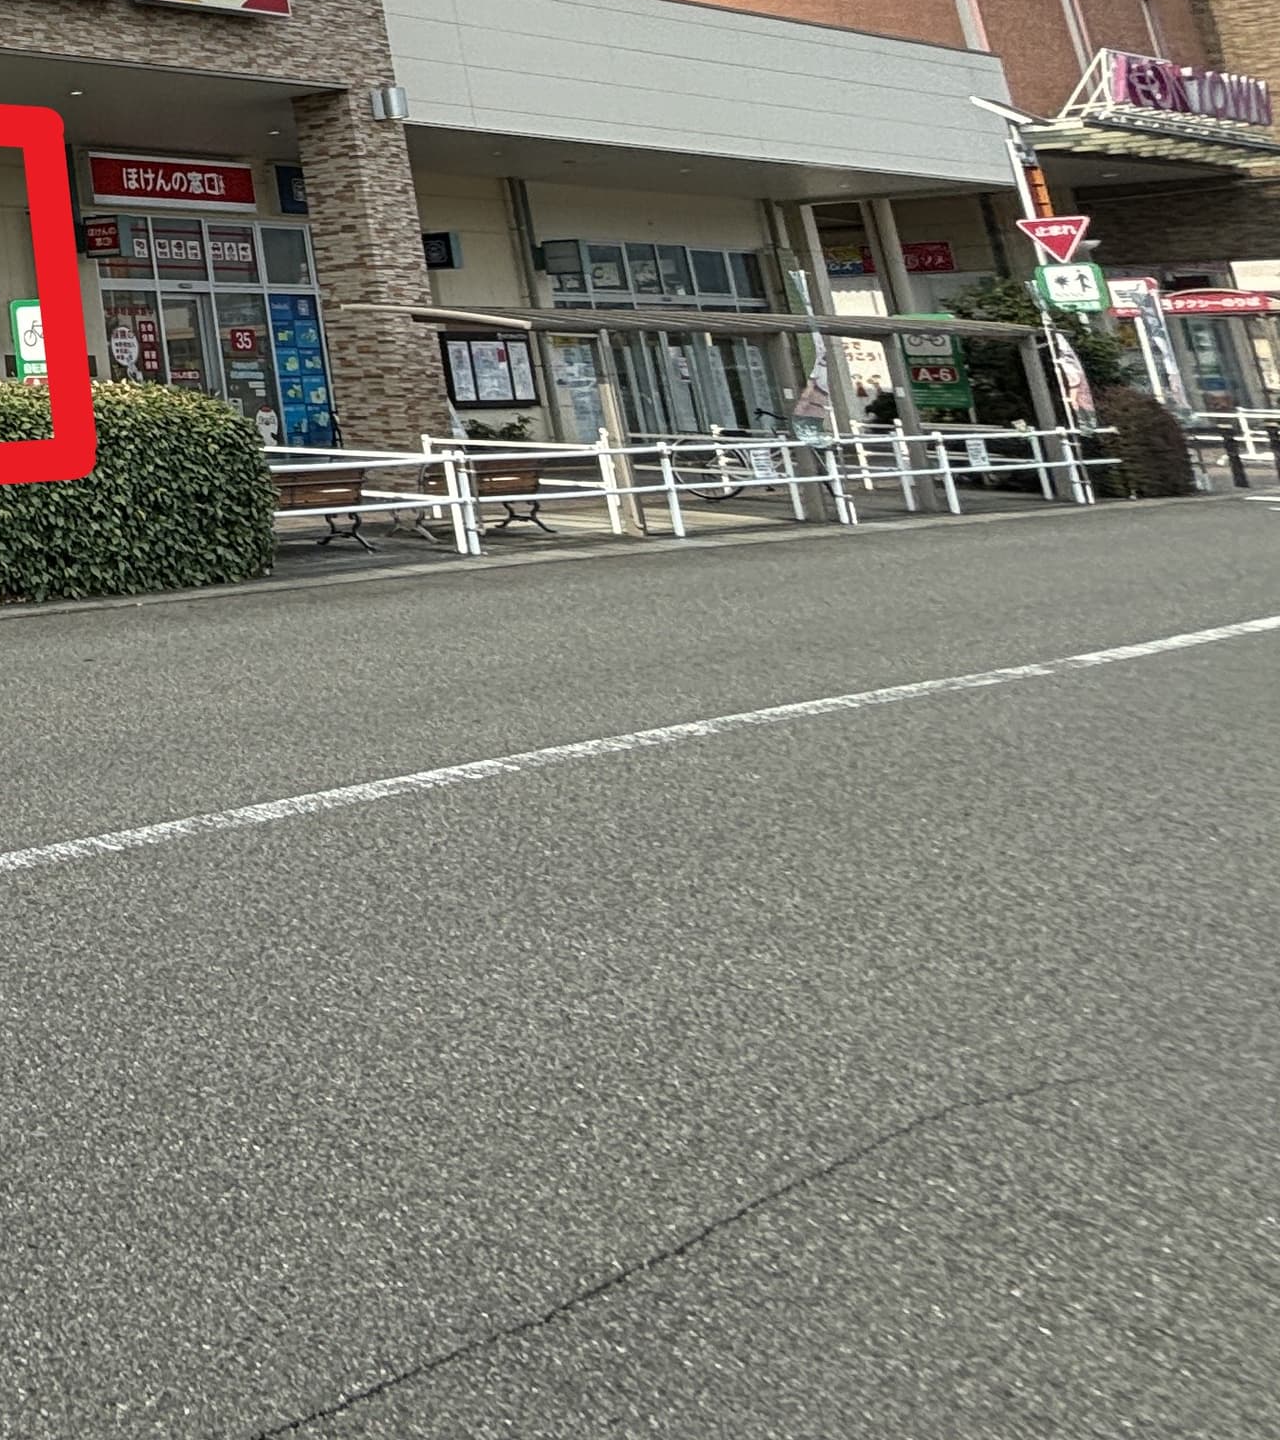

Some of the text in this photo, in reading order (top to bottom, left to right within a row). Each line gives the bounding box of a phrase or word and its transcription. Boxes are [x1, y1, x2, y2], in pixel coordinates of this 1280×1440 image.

[122, 167, 225, 196] ほけんの窓口
[235, 332, 252, 350] 35
